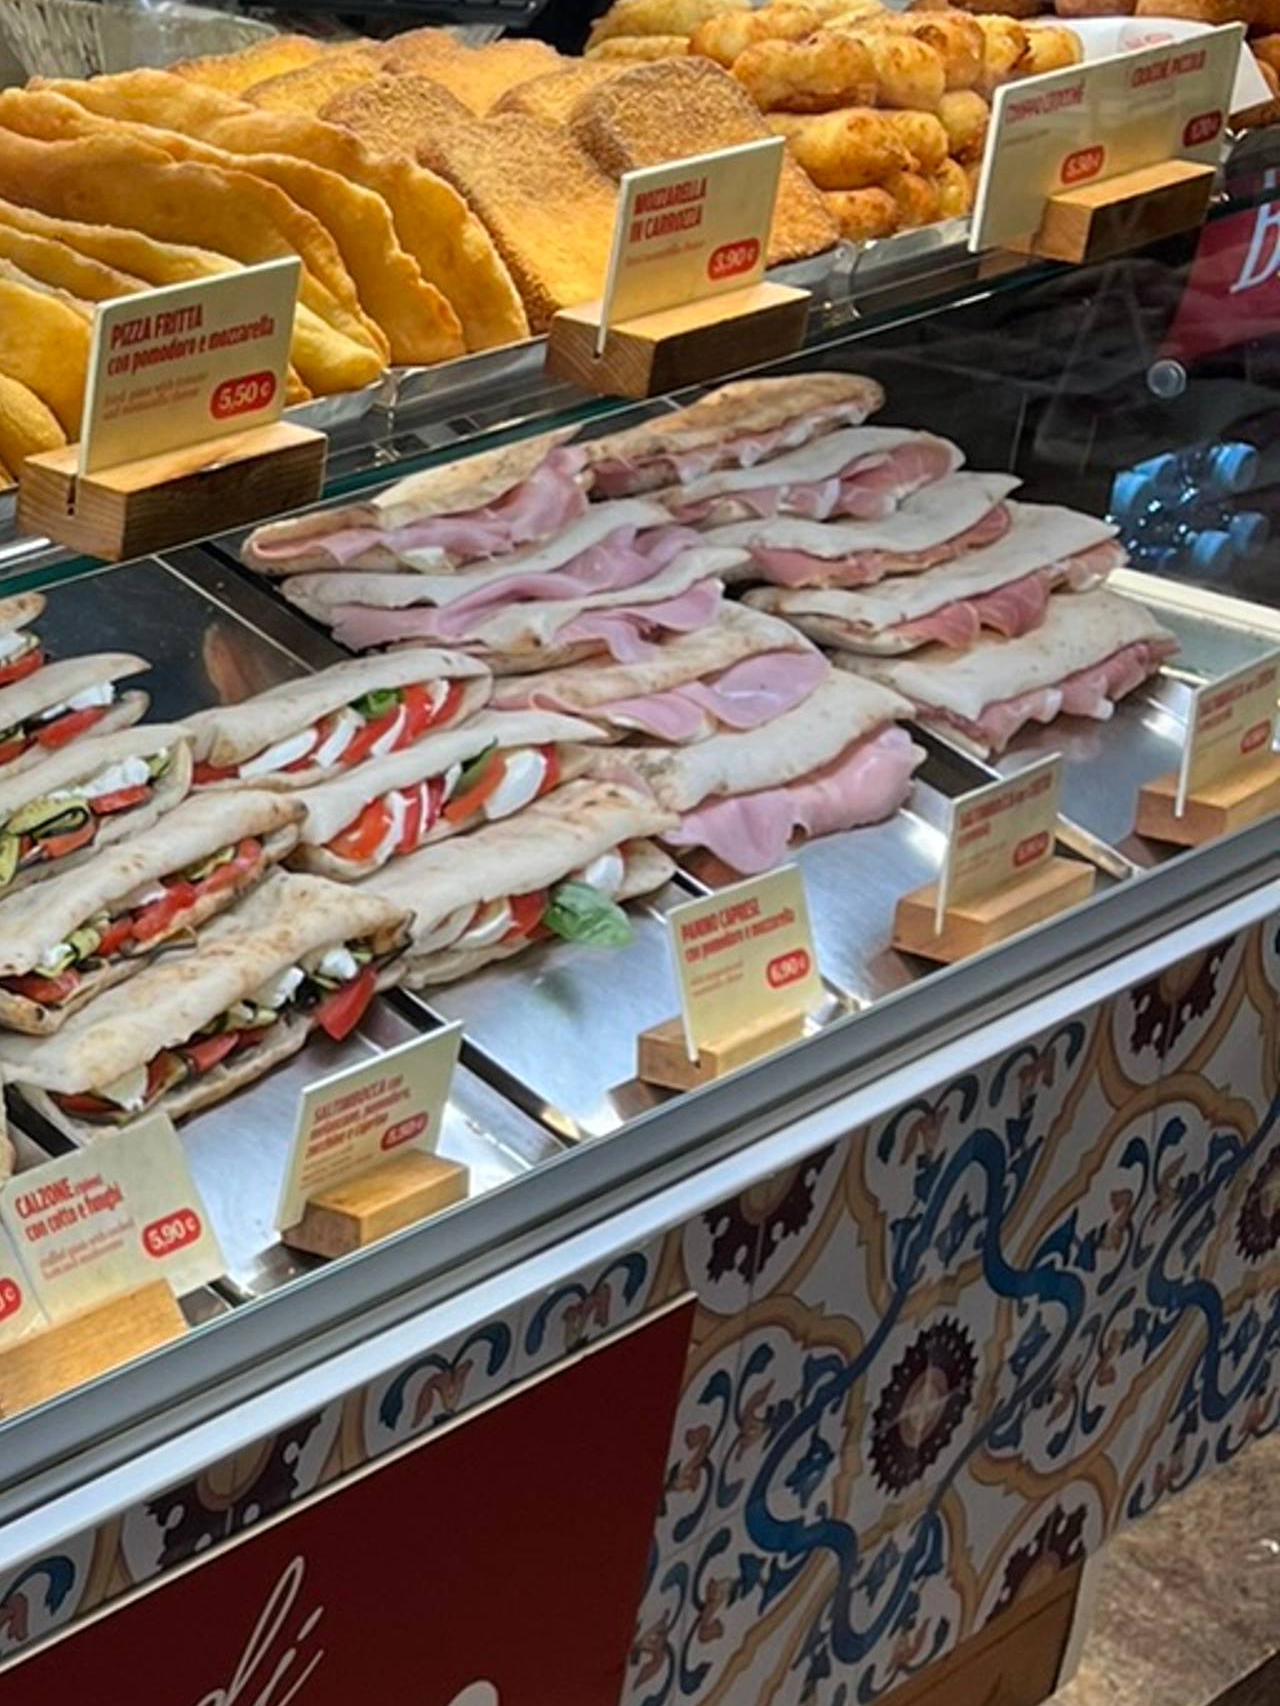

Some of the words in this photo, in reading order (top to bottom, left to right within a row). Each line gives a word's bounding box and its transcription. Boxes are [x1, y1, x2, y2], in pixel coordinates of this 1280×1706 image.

[111, 317, 151, 351] PIZZA
[154, 303, 203, 338] FRITTA
[107, 352, 131, 376] con
[132, 338, 197, 375] pomodoro
[15, 1177, 74, 1219] CALZONE
